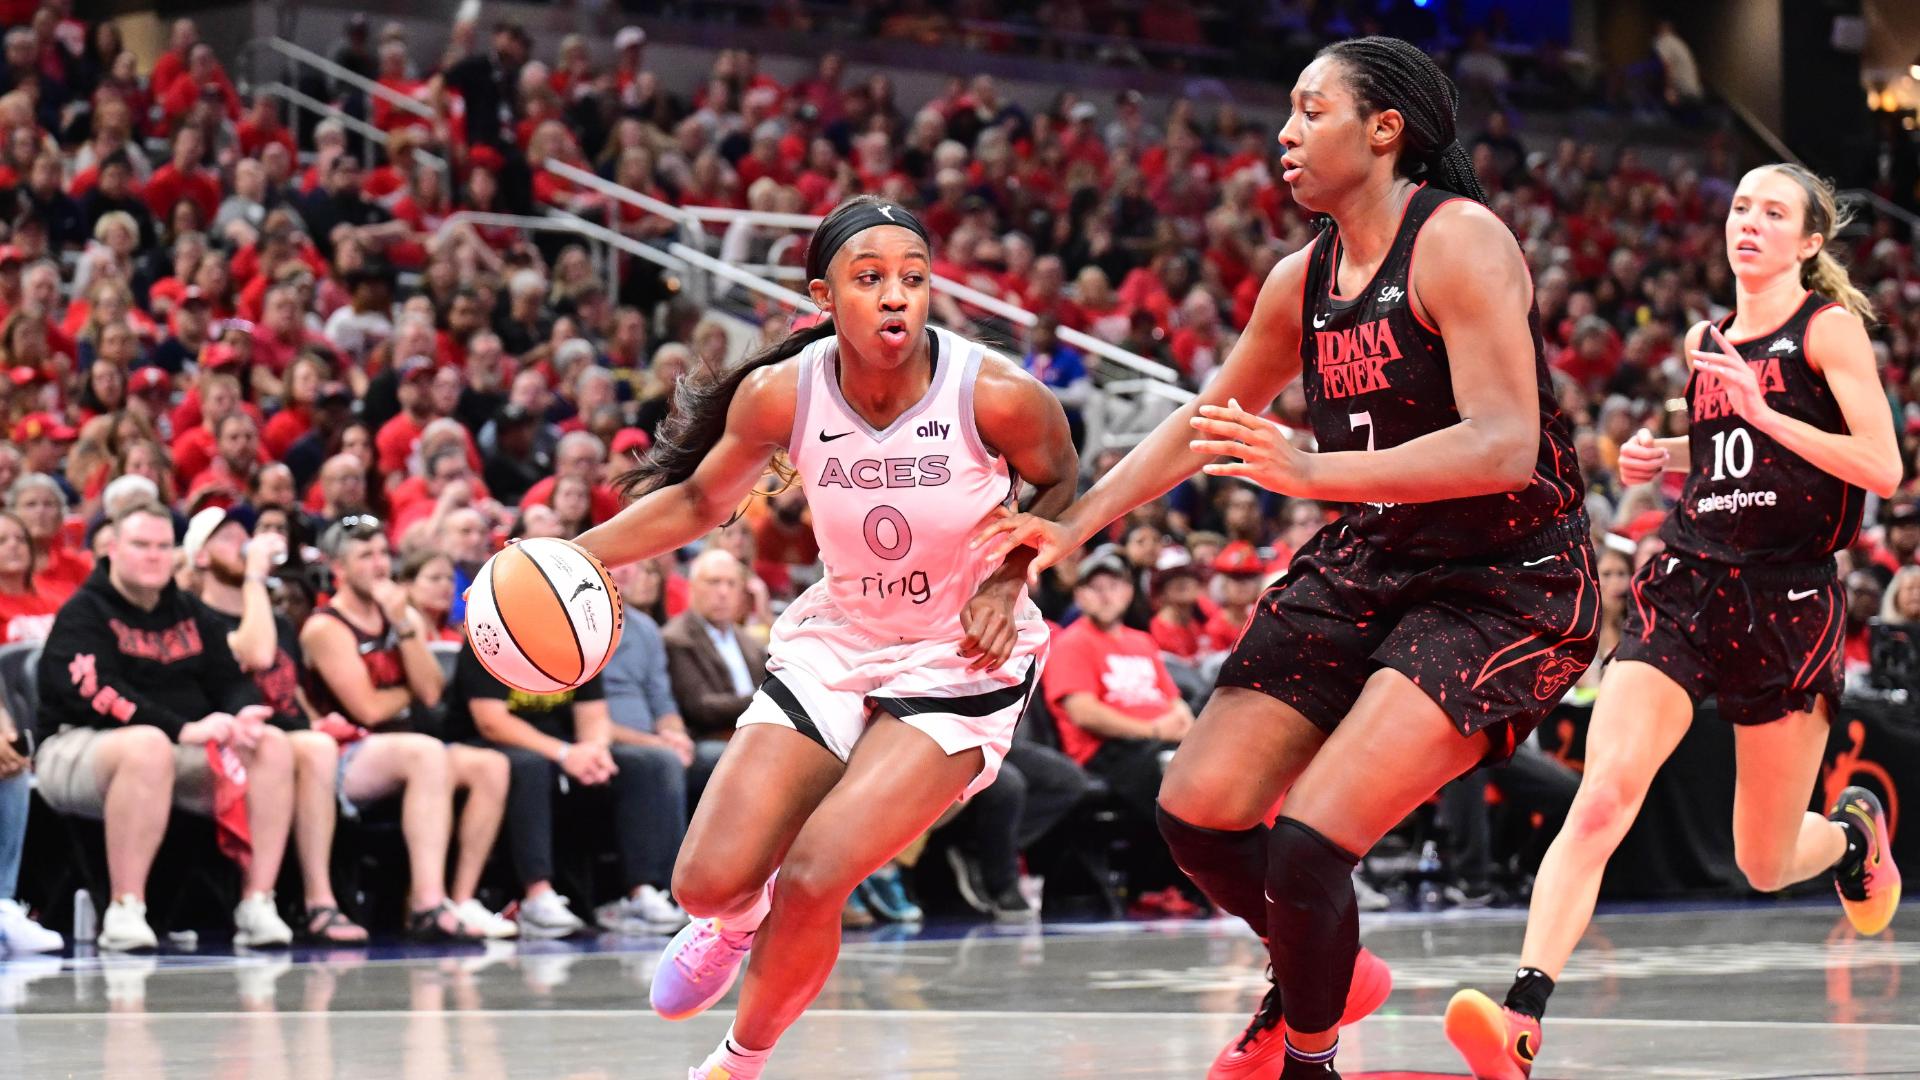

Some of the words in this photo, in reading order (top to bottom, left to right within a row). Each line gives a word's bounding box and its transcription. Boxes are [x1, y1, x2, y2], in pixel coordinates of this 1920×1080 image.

[916, 420, 951, 440] ally
[1348, 410, 1375, 452] 7
[818, 454, 951, 490] ACES
[1711, 427, 1754, 481] 10
[1697, 488, 1778, 514] salesforce
[862, 504, 913, 561] 0
[861, 570, 932, 605] ring
